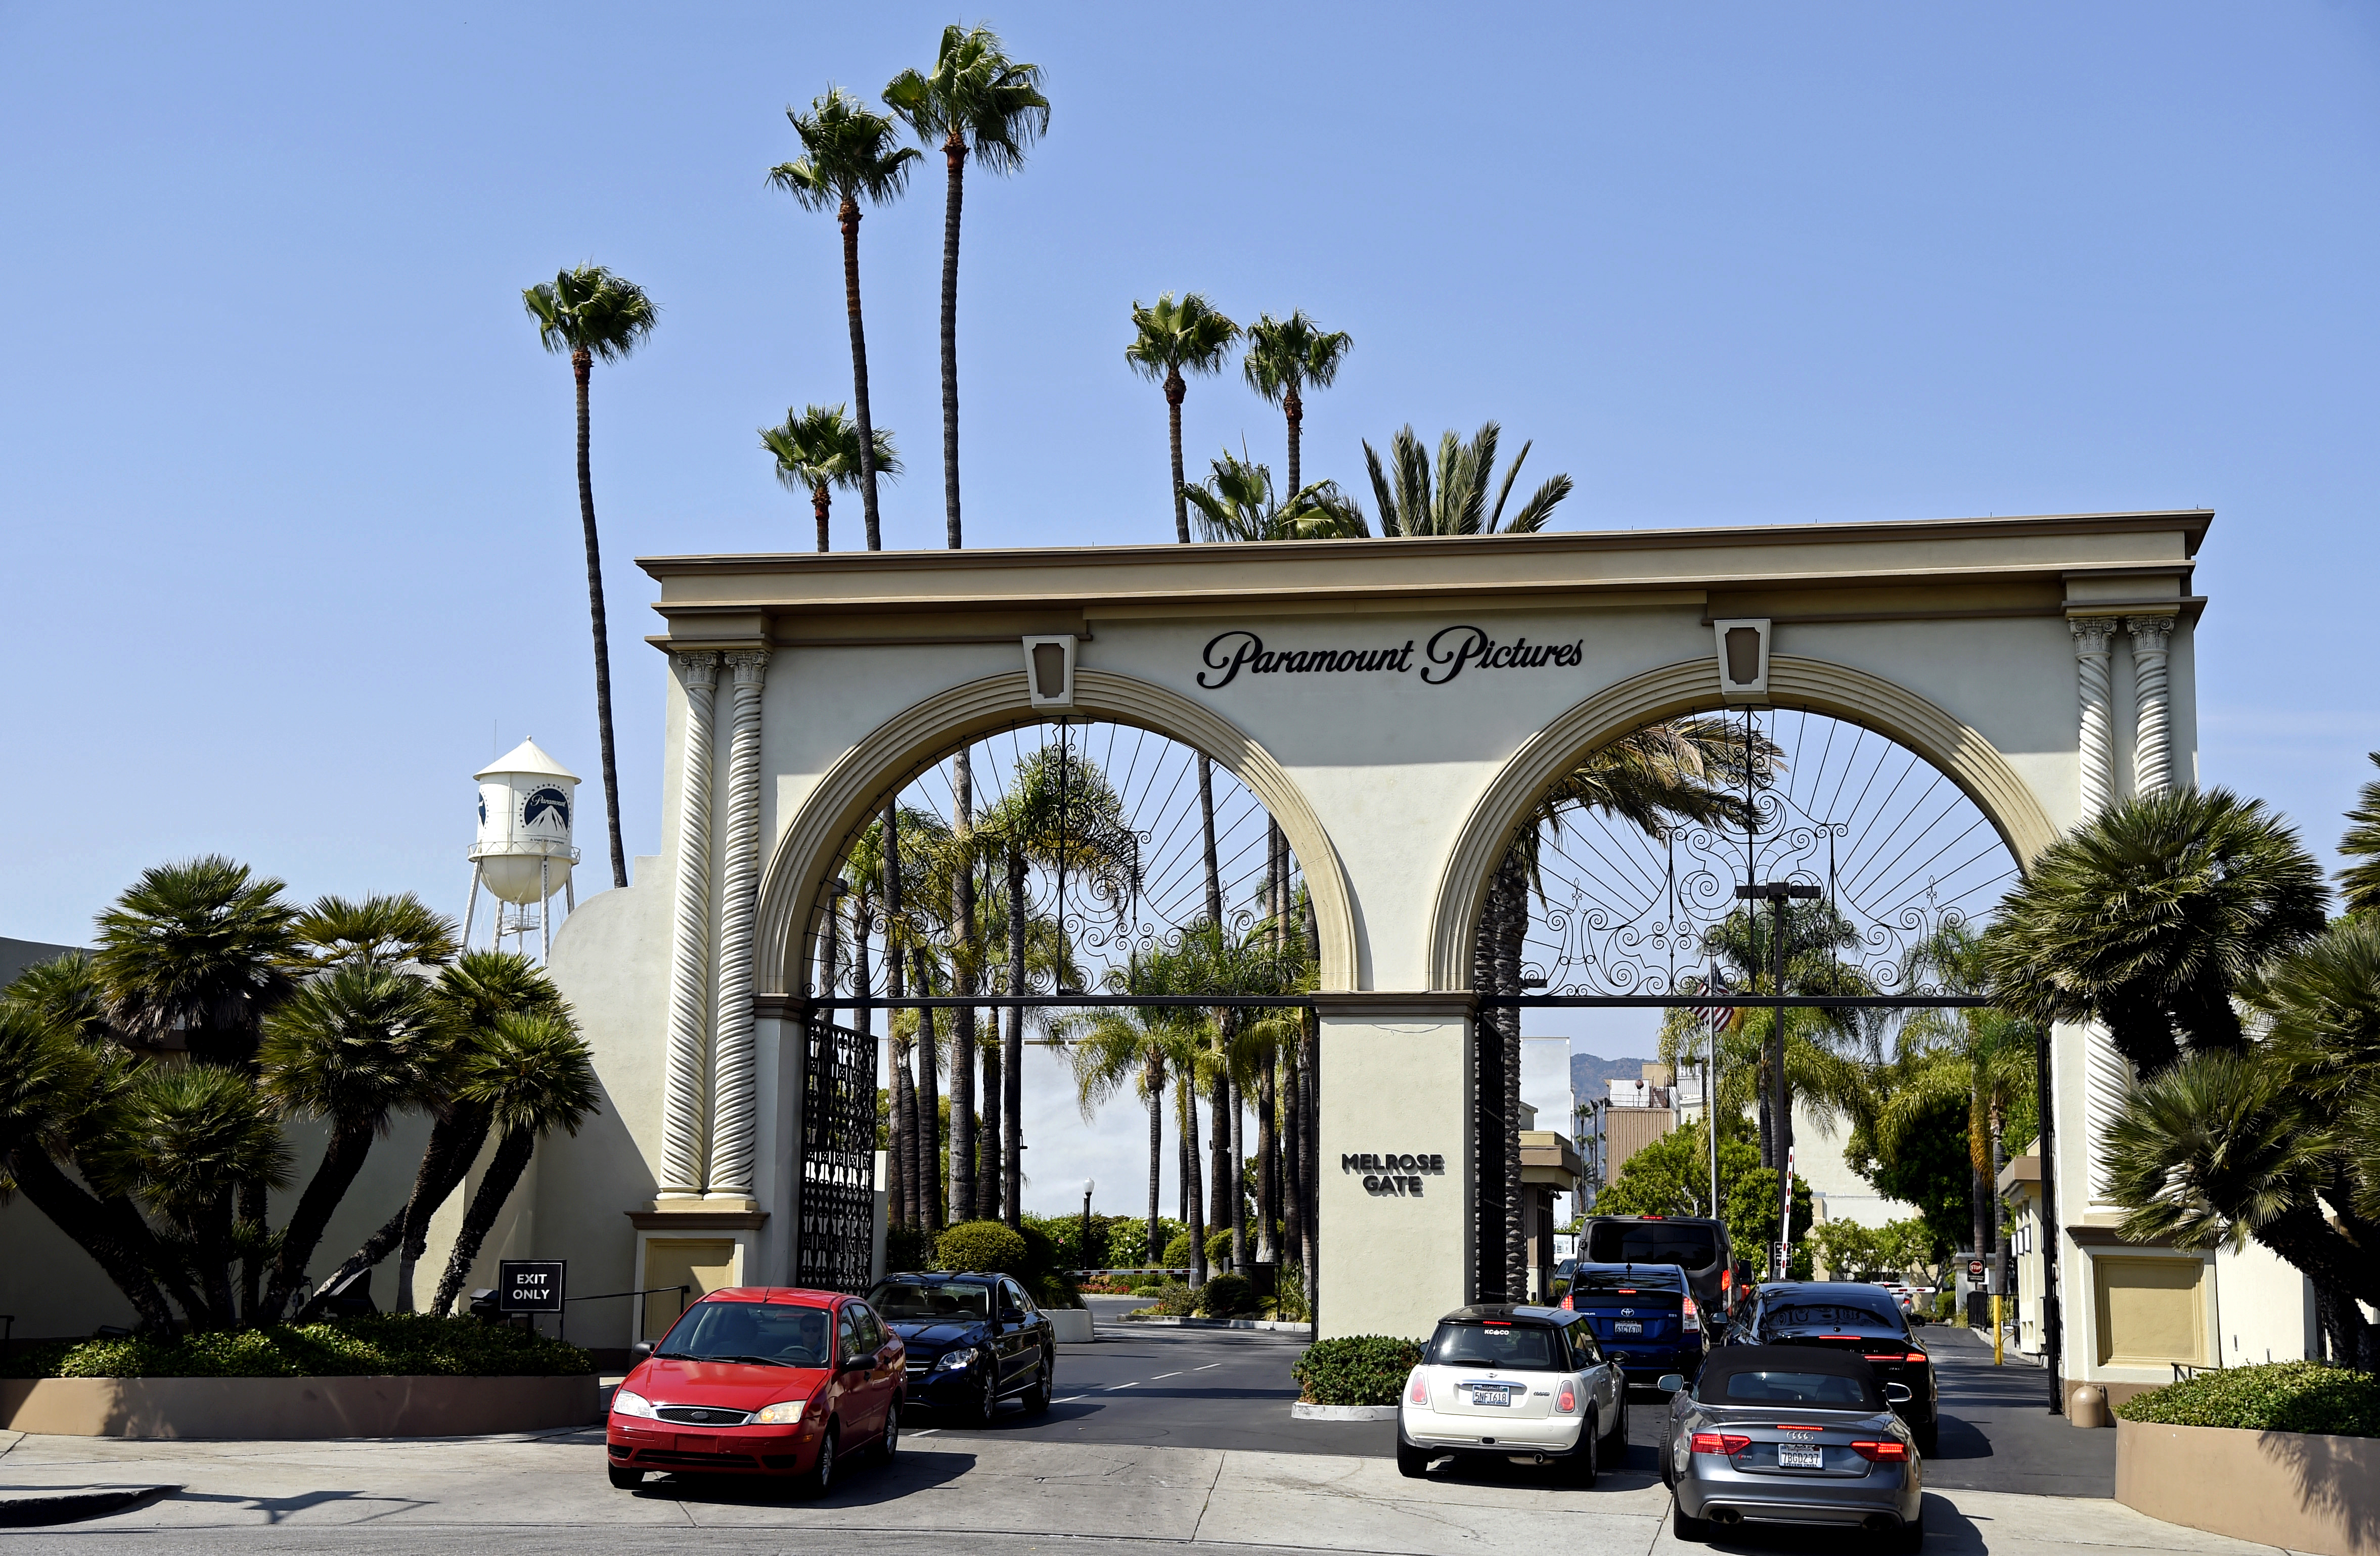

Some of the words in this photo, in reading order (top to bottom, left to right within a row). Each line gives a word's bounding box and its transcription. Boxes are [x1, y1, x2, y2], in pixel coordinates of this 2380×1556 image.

[1196, 630, 1414, 689] Paramount
[1420, 625, 1584, 684] Pictures
[530, 794, 566, 807] Paramount
[1341, 1153, 1443, 1171] MELROSE
[1363, 1175, 1421, 1192] GATE
[517, 1273, 548, 1284] EXIT
[513, 1289, 550, 1300] ONLY
[1475, 1392, 1506, 1402] 5NFT618
[1781, 1452, 1819, 1463] 7BGD237
